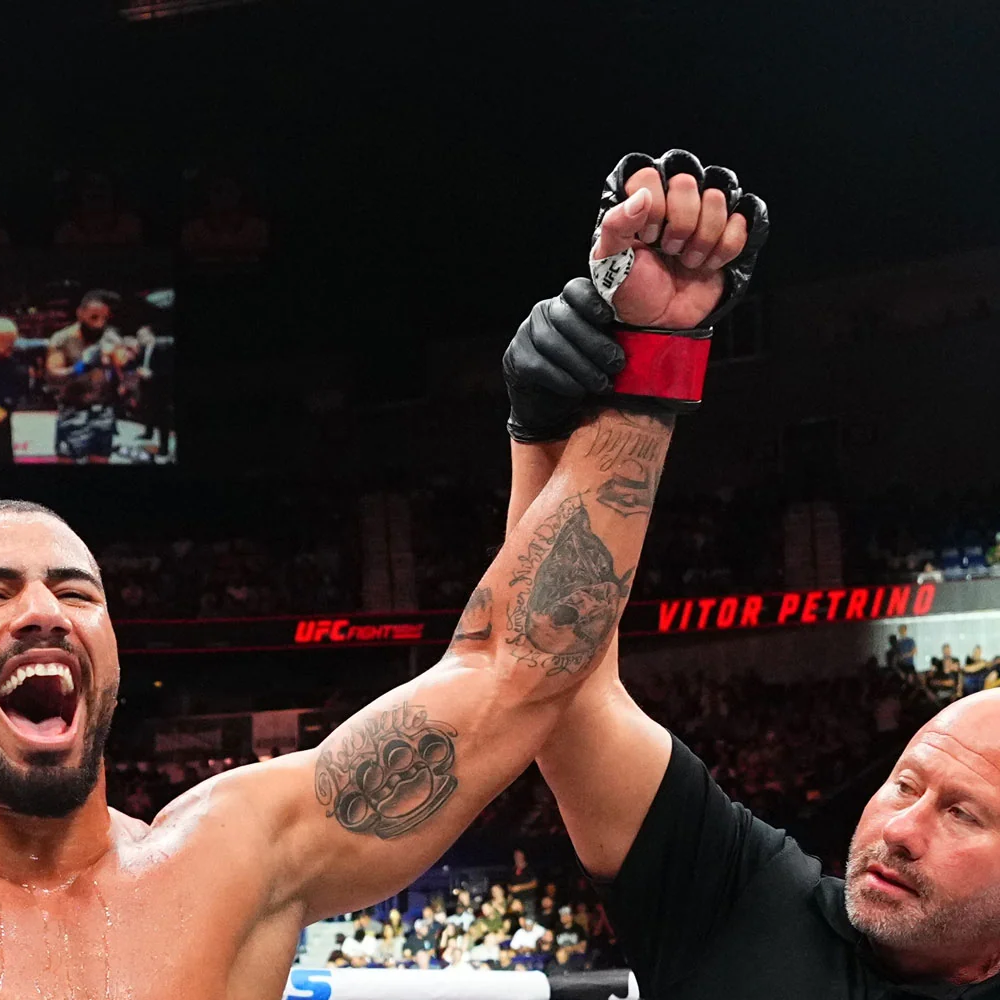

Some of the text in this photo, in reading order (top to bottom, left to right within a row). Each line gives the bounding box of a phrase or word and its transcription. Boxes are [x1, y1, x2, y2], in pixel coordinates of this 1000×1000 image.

[602, 260, 621, 289] UFC
[658, 583, 937, 634] VITOR PETRINO
[294, 619, 349, 643] UFC
